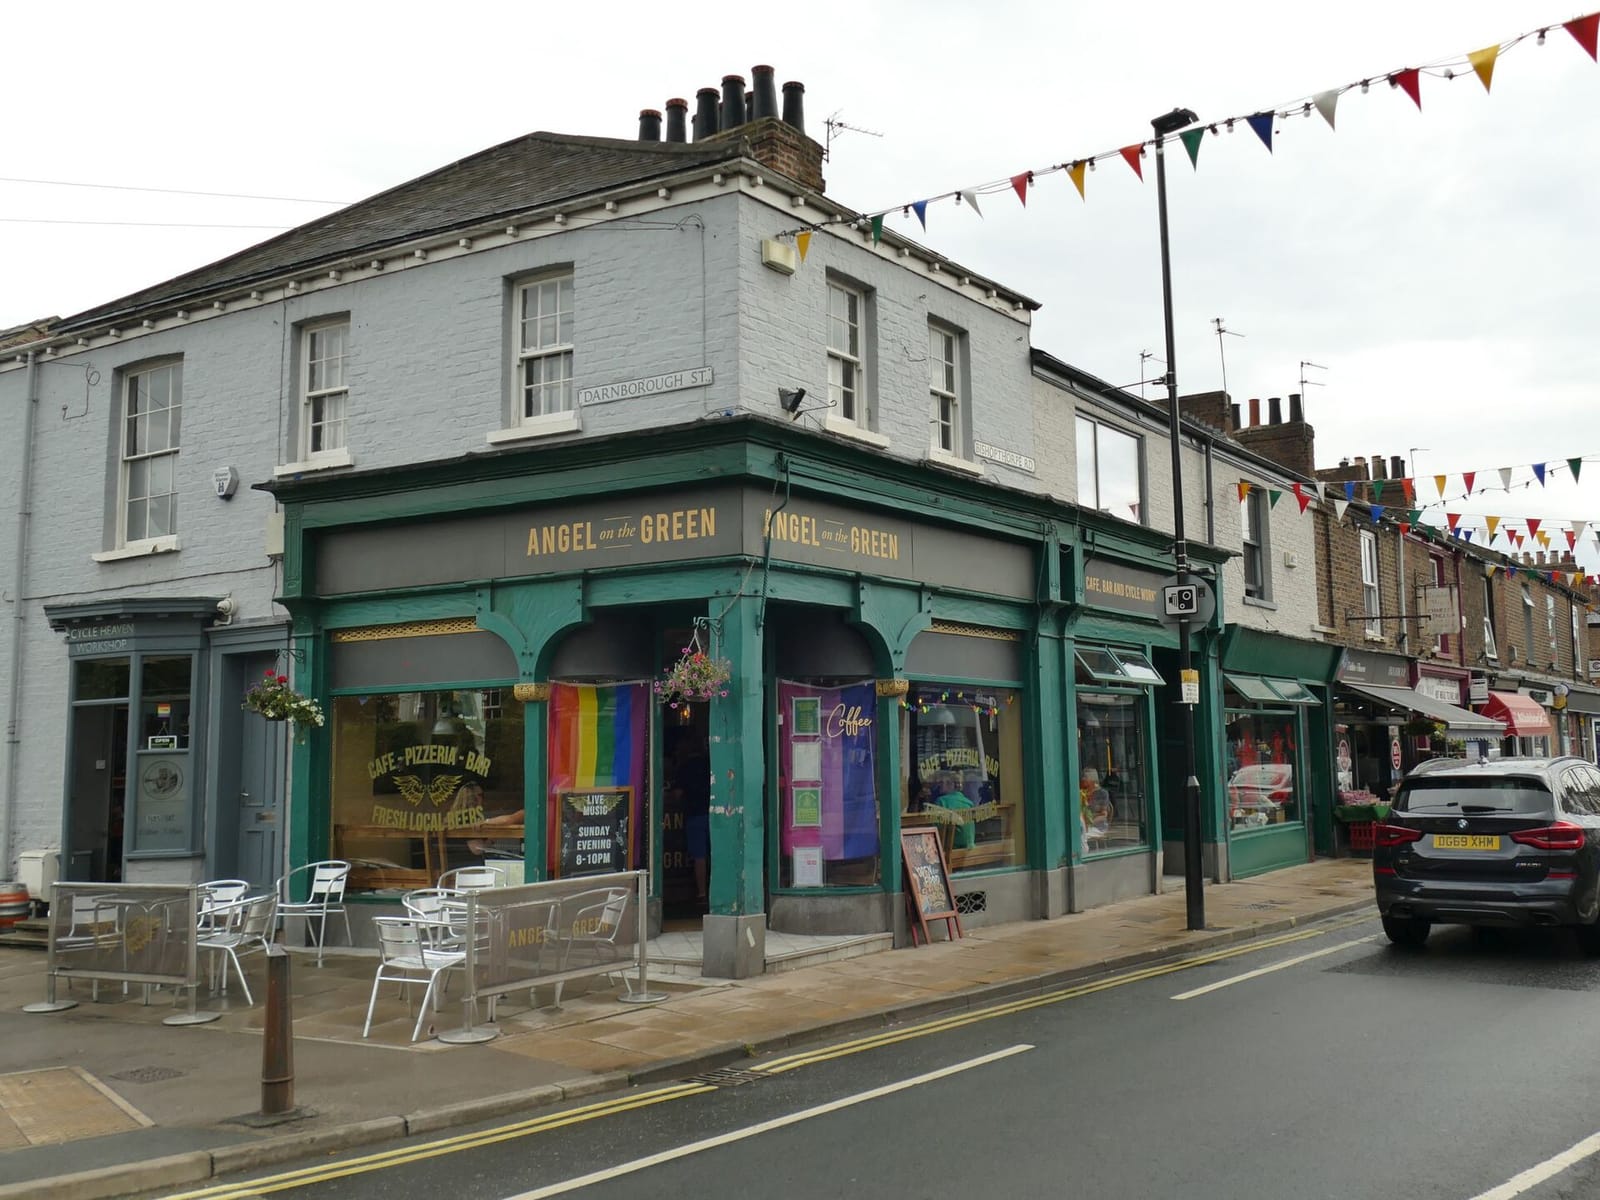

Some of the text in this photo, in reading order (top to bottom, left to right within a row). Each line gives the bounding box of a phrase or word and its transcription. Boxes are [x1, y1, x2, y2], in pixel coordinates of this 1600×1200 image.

[584, 374, 683, 403] DARNBOROUGH
[527, 507, 716, 556] ANGEL on the GREEN
[762, 508, 899, 560] ANGEL on the GREEN
[1102, 579, 1113, 594] BAR
[1114, 582, 1124, 597] AND
[1125, 584, 1140, 600] CYCLE
[71, 623, 135, 639] CYCLE HEAVEN
[76, 639, 128, 653] WORKSHOP
[827, 703, 872, 738] Coffee
[368, 752, 396, 779] CAFE
[405, 745, 457, 766] PIZZERIA
[465, 751, 491, 778] BAR
[946, 748, 979, 767] PIZZERIA
[985, 754, 999, 777] BAR
[587, 795, 605, 805] LIVE
[372, 805, 484, 831] FRESH LOCAL BEERS
[583, 805, 608, 816] MUSIC
[578, 825, 610, 837] SUNDAY
[576, 839, 612, 850] EVENING
[1438, 836, 1494, 848] DG69 XHM
[576, 852, 611, 866] 8-10PM
